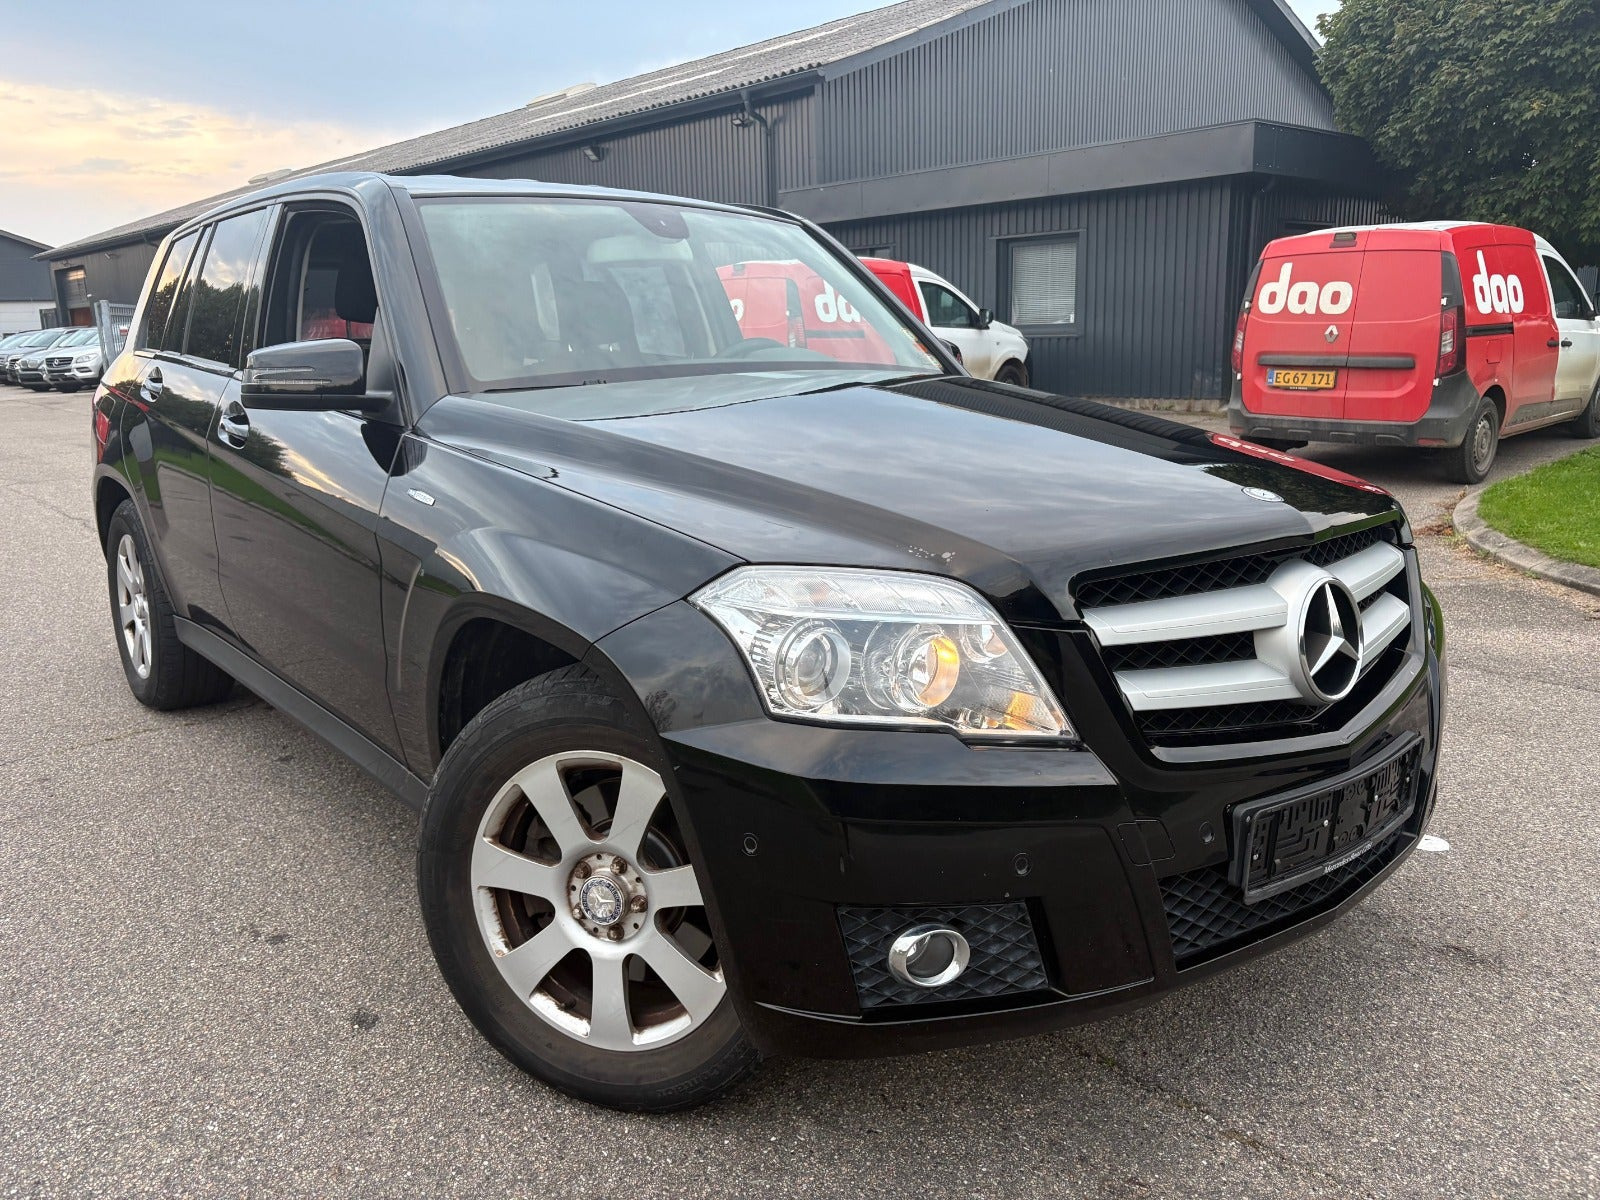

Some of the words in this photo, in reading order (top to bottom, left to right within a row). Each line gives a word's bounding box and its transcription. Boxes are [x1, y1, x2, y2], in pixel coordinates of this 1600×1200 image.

[814, 280, 861, 323] da
[1258, 262, 1353, 314] dao
[1472, 250, 1524, 314] dao
[1311, 373, 1330, 385] 171
